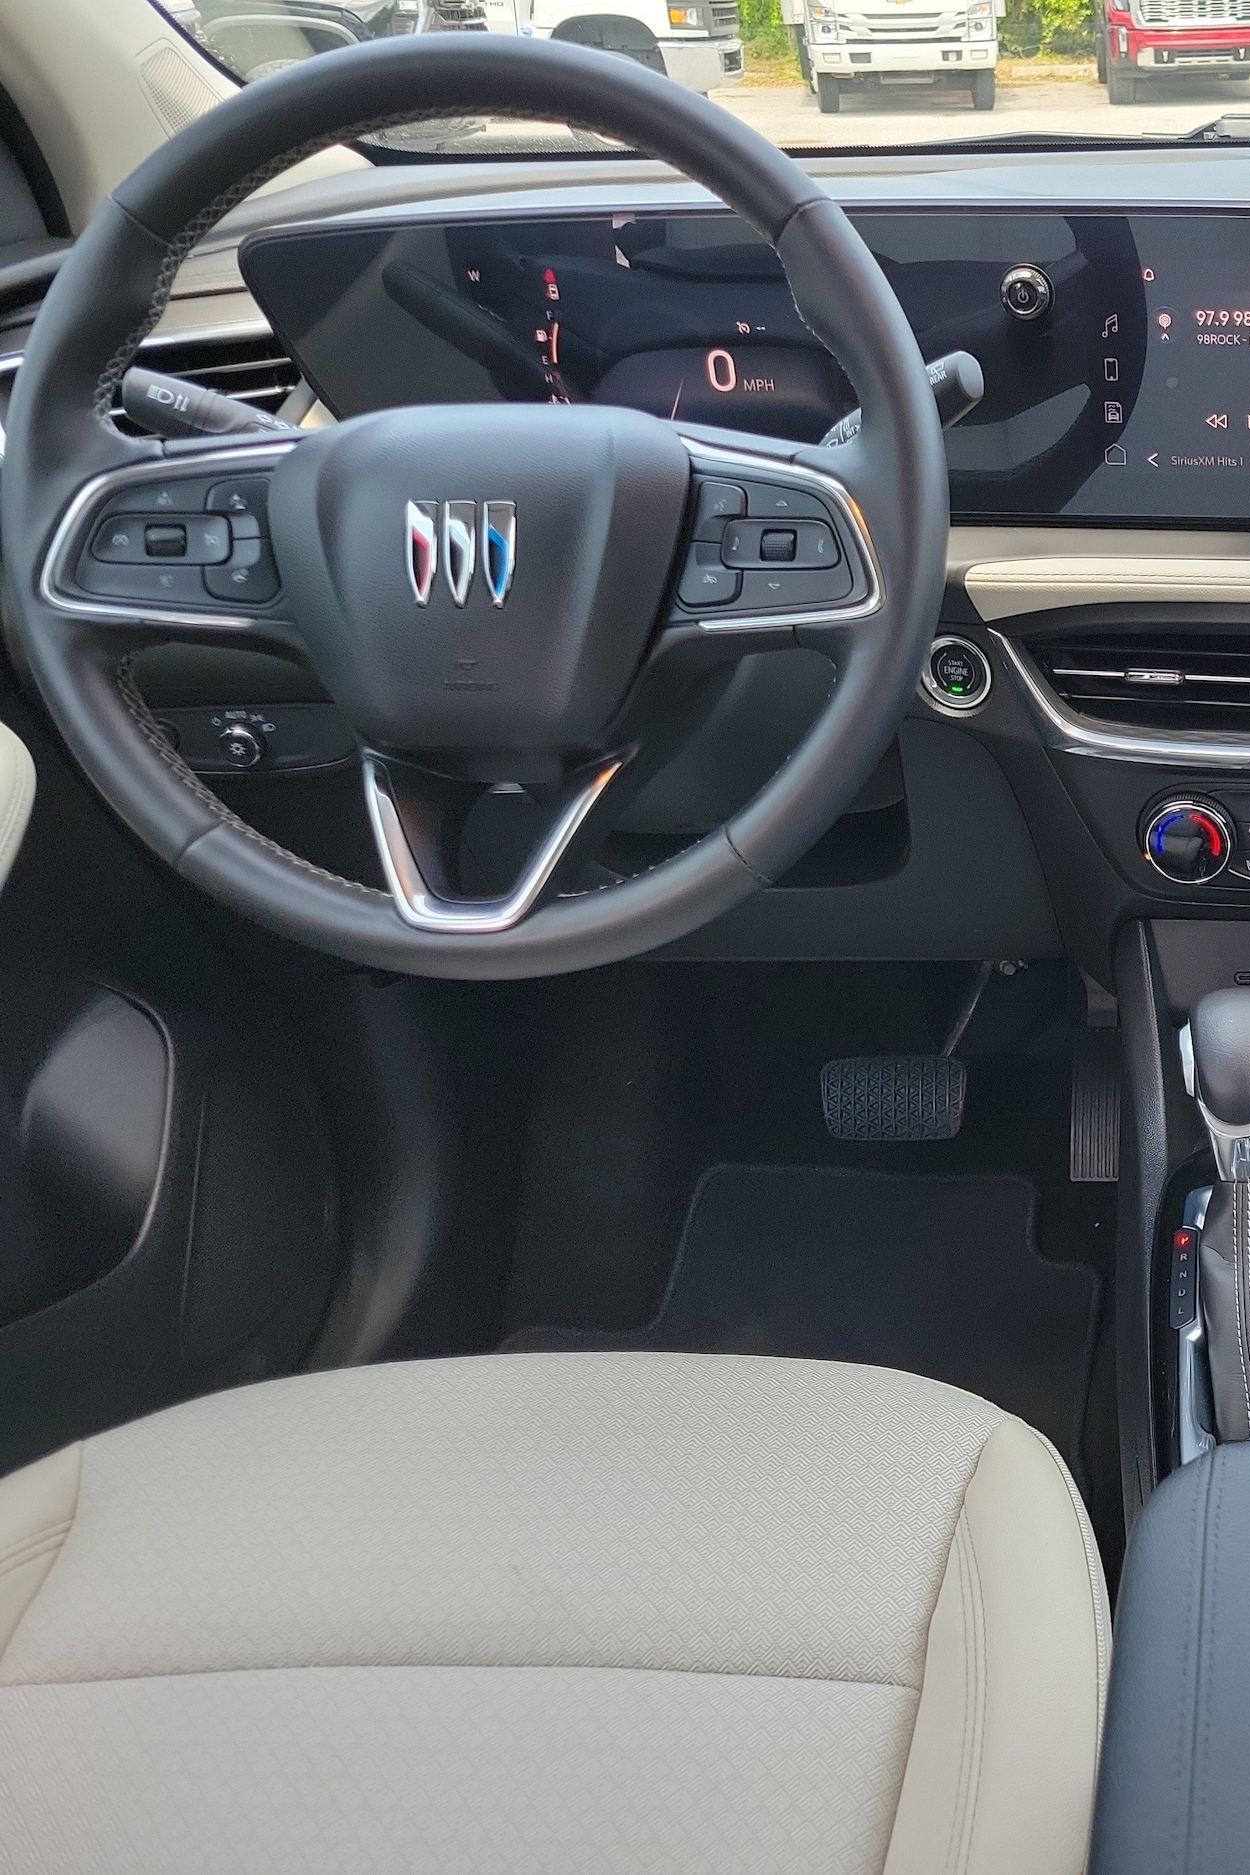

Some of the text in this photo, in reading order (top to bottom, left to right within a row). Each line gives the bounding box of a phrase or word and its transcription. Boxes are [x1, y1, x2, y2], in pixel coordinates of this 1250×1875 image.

[467, 270, 480, 282] W
[1196, 310, 1229, 327] 97.9
[1196, 334, 1241, 346] 98ROCK
[708, 349, 775, 392] 0 MPH
[1171, 455, 1214, 466] SiriusXM
[1217, 456, 1237, 466] Hits
[944, 666, 969, 677] ENGINE
[1180, 1253, 1188, 1261] R
[1179, 1270, 1187, 1279] N
[1178, 1288, 1186, 1297] D
[1178, 1307, 1184, 1315] L
